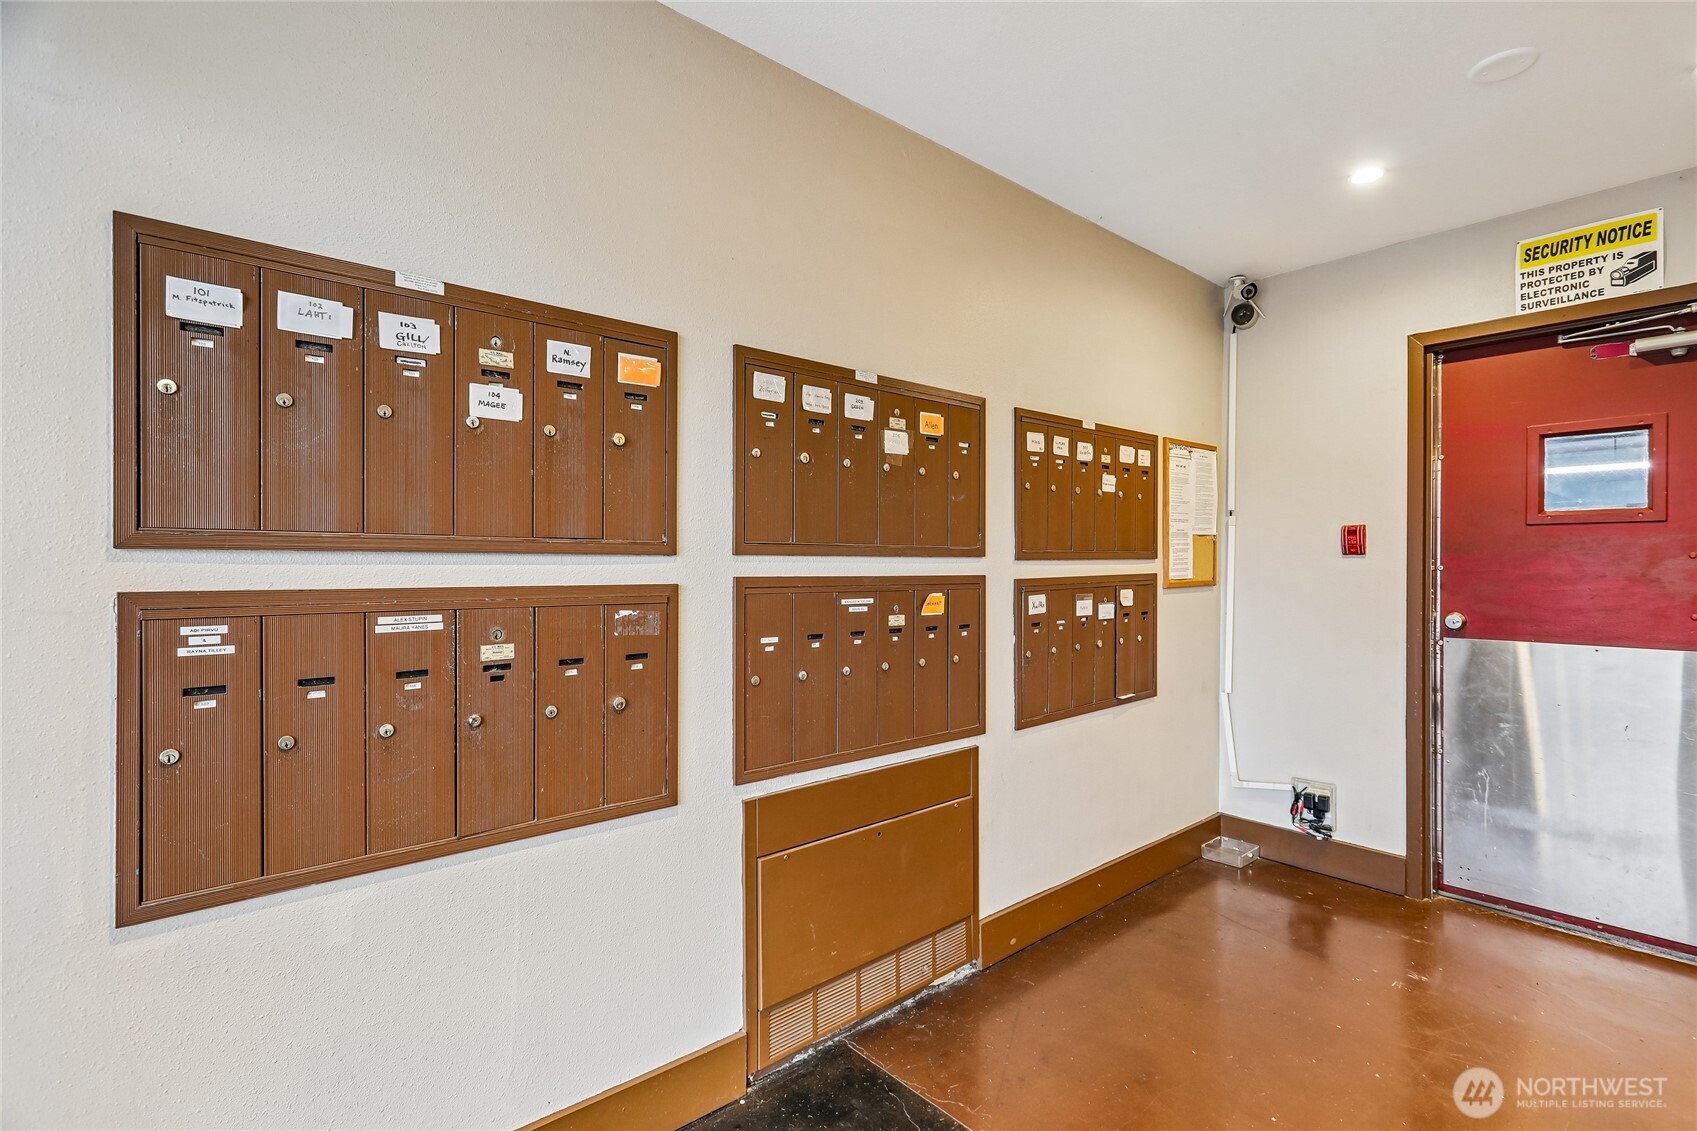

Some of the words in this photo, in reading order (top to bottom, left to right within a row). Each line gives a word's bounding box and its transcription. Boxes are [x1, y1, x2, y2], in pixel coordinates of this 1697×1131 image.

[1524, 232, 1593, 263] SECURITY
[1596, 220, 1652, 247] NOTICE
[1520, 268, 1545, 280] THIS
[1549, 254, 1609, 274] PROPERTY
[1612, 251, 1624, 260] IS
[1520, 270, 1585, 290] PROTECTED
[1589, 266, 1605, 277] BY
[193, 287, 210, 297] 101
[1520, 280, 1590, 301] ELECTRONIC
[186, 295, 236, 309] Fitzpatrick
[309, 301, 323, 310] 102
[1520, 288, 1605, 311] SURVEILLANCE
[400, 321, 417, 330] 103
[551, 354, 587, 373] Ramsey
[488, 391, 501, 399] 104
[478, 400, 507, 409] MAGEE
[924, 421, 939, 430] Allen
